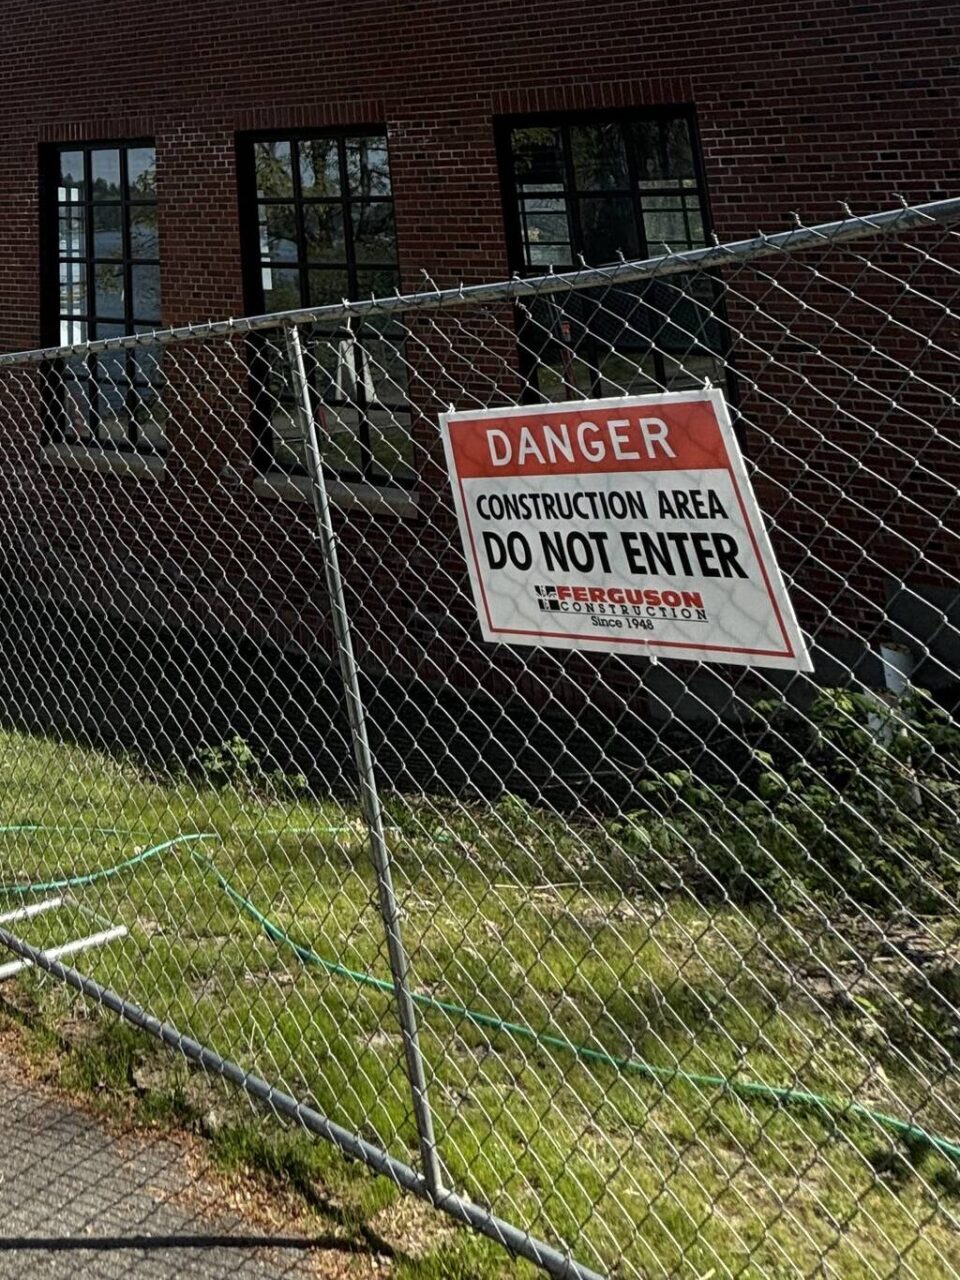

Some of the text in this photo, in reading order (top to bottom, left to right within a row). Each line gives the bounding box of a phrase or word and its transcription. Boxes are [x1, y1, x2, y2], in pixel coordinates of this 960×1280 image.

[486, 417, 677, 466] DANGER
[476, 490, 729, 520] CONSTRUCTION AREA
[482, 531, 749, 579] DO NOT ENTER
[556, 586, 704, 608] FERGUSON
[561, 601, 707, 620] CONSTRUCTION
[591, 616, 654, 630] Since 1948
